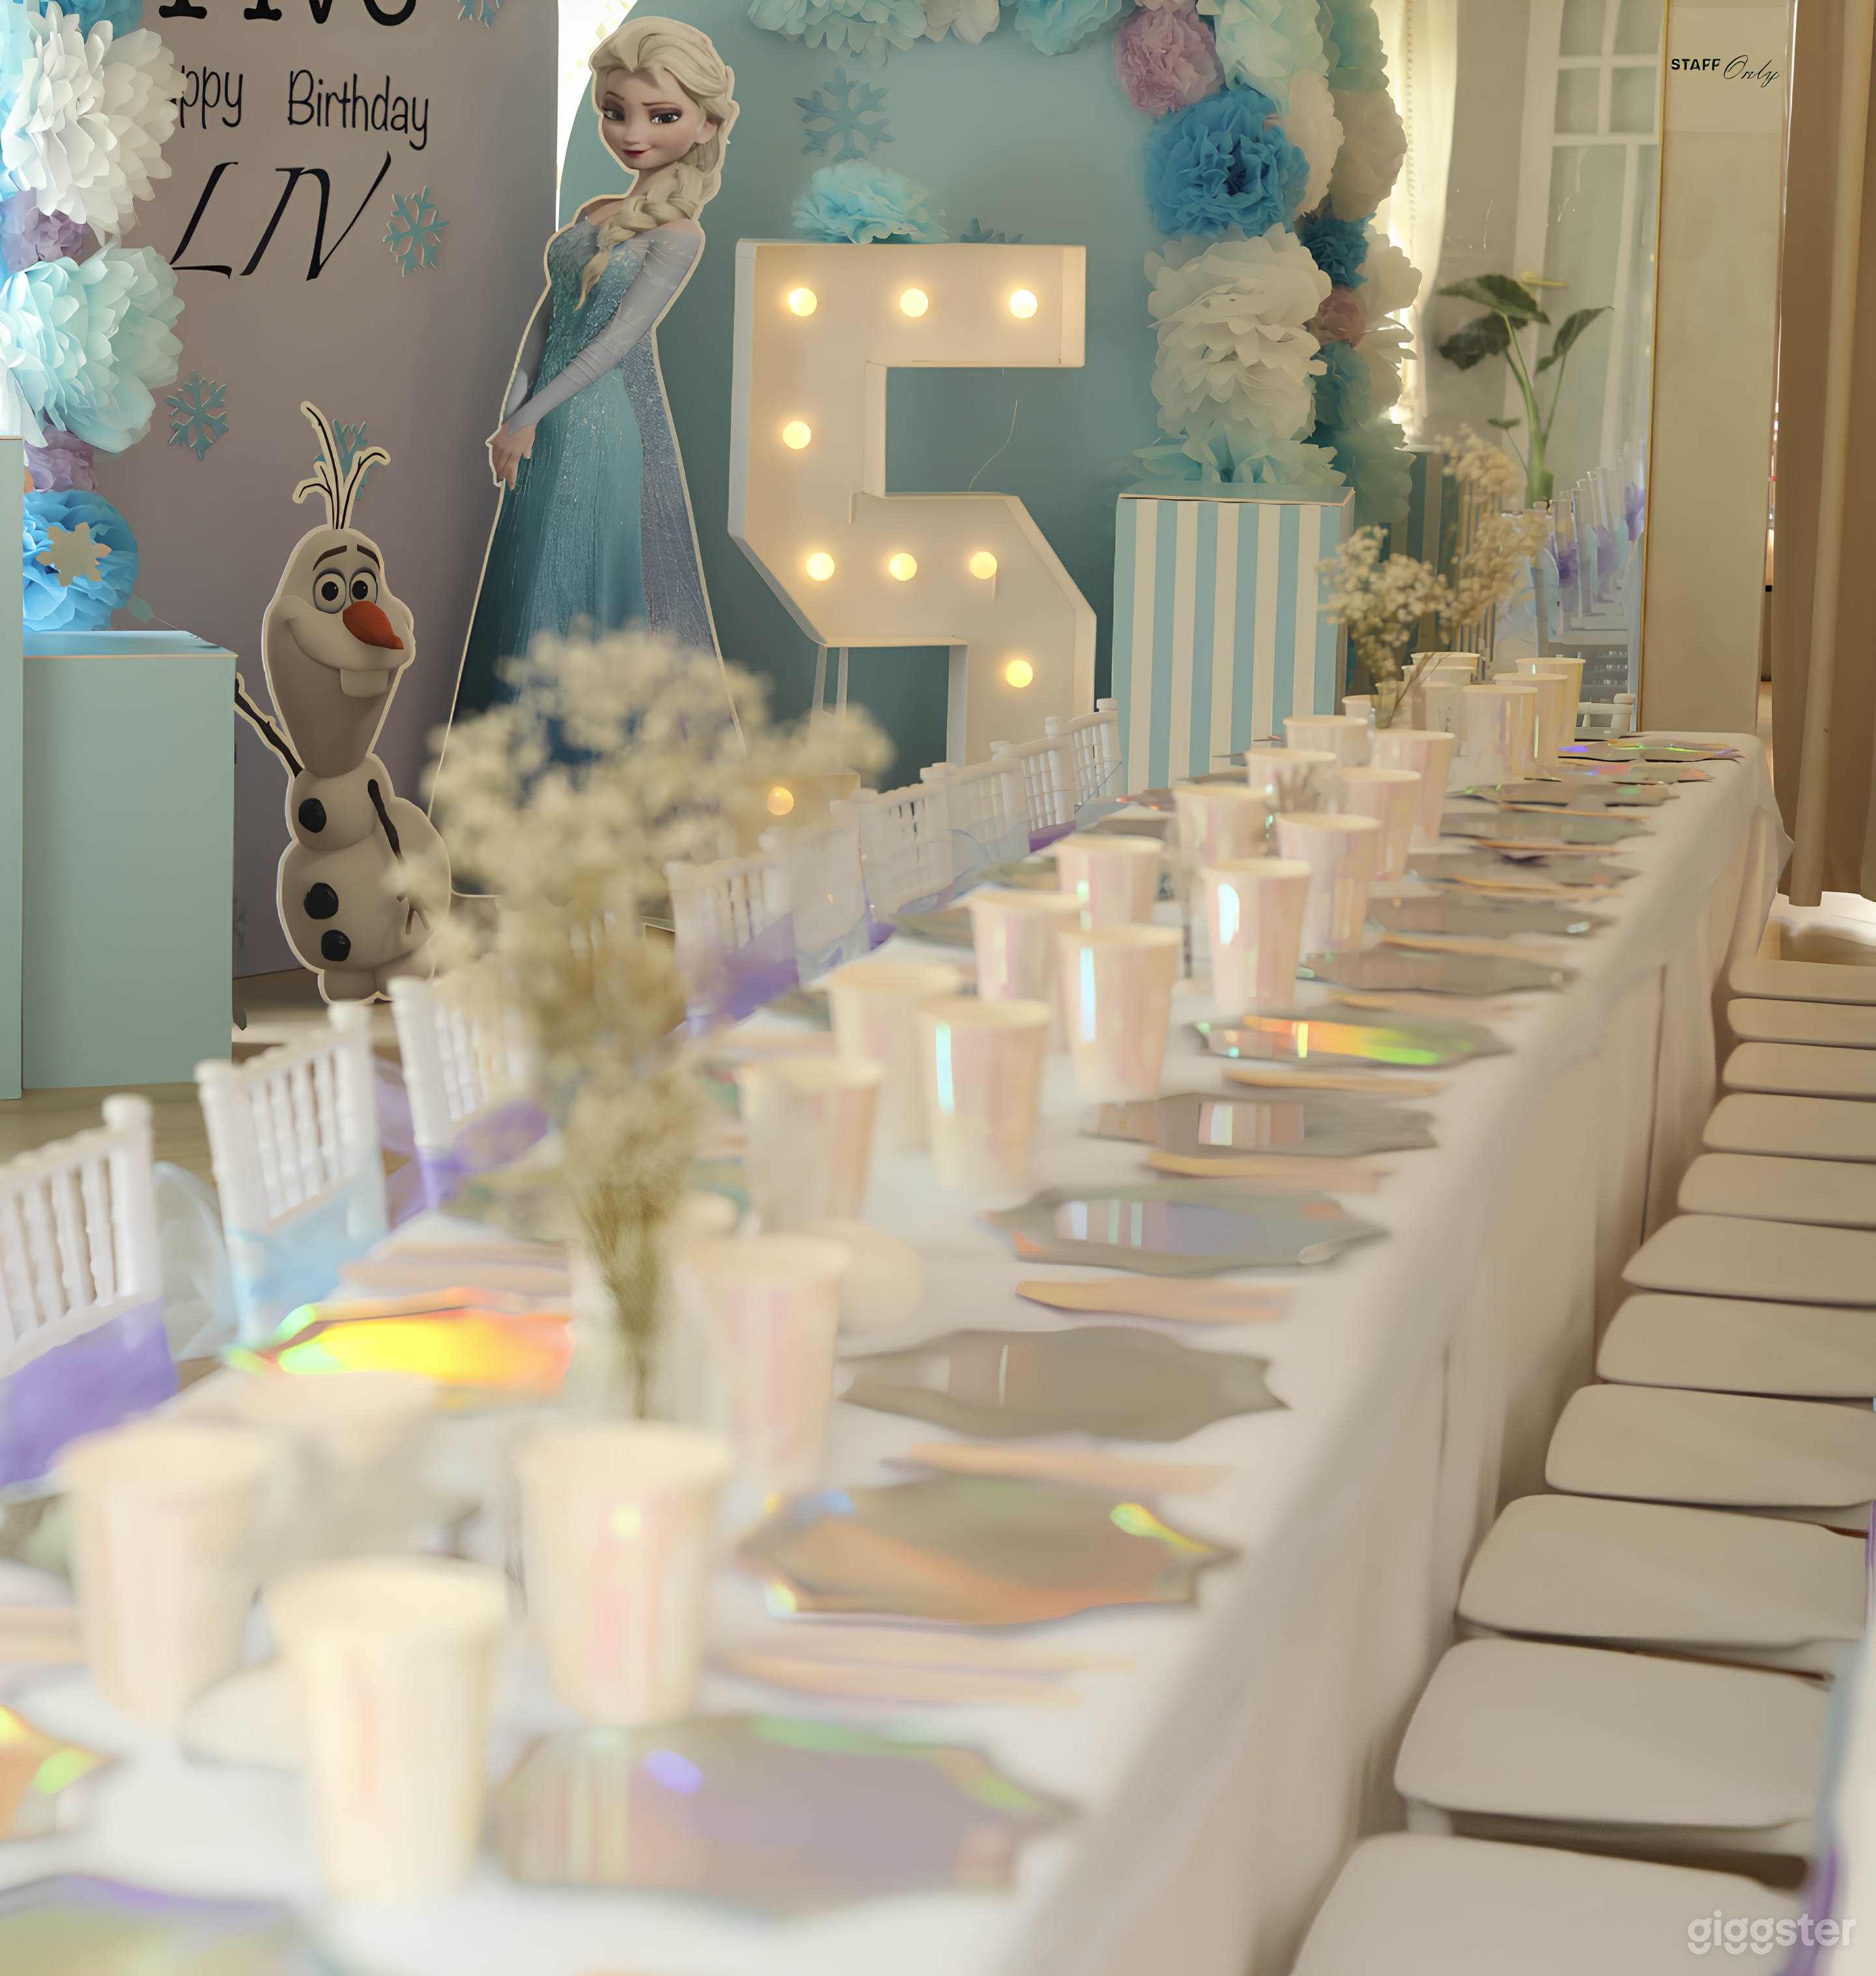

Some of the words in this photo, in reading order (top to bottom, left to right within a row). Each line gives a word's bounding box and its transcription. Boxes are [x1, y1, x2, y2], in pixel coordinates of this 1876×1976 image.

[1671, 58, 1722, 71] STAFF
[1723, 54, 1780, 88] Only
[166, 64, 244, 130] ppy
[287, 69, 429, 150] Birthday
